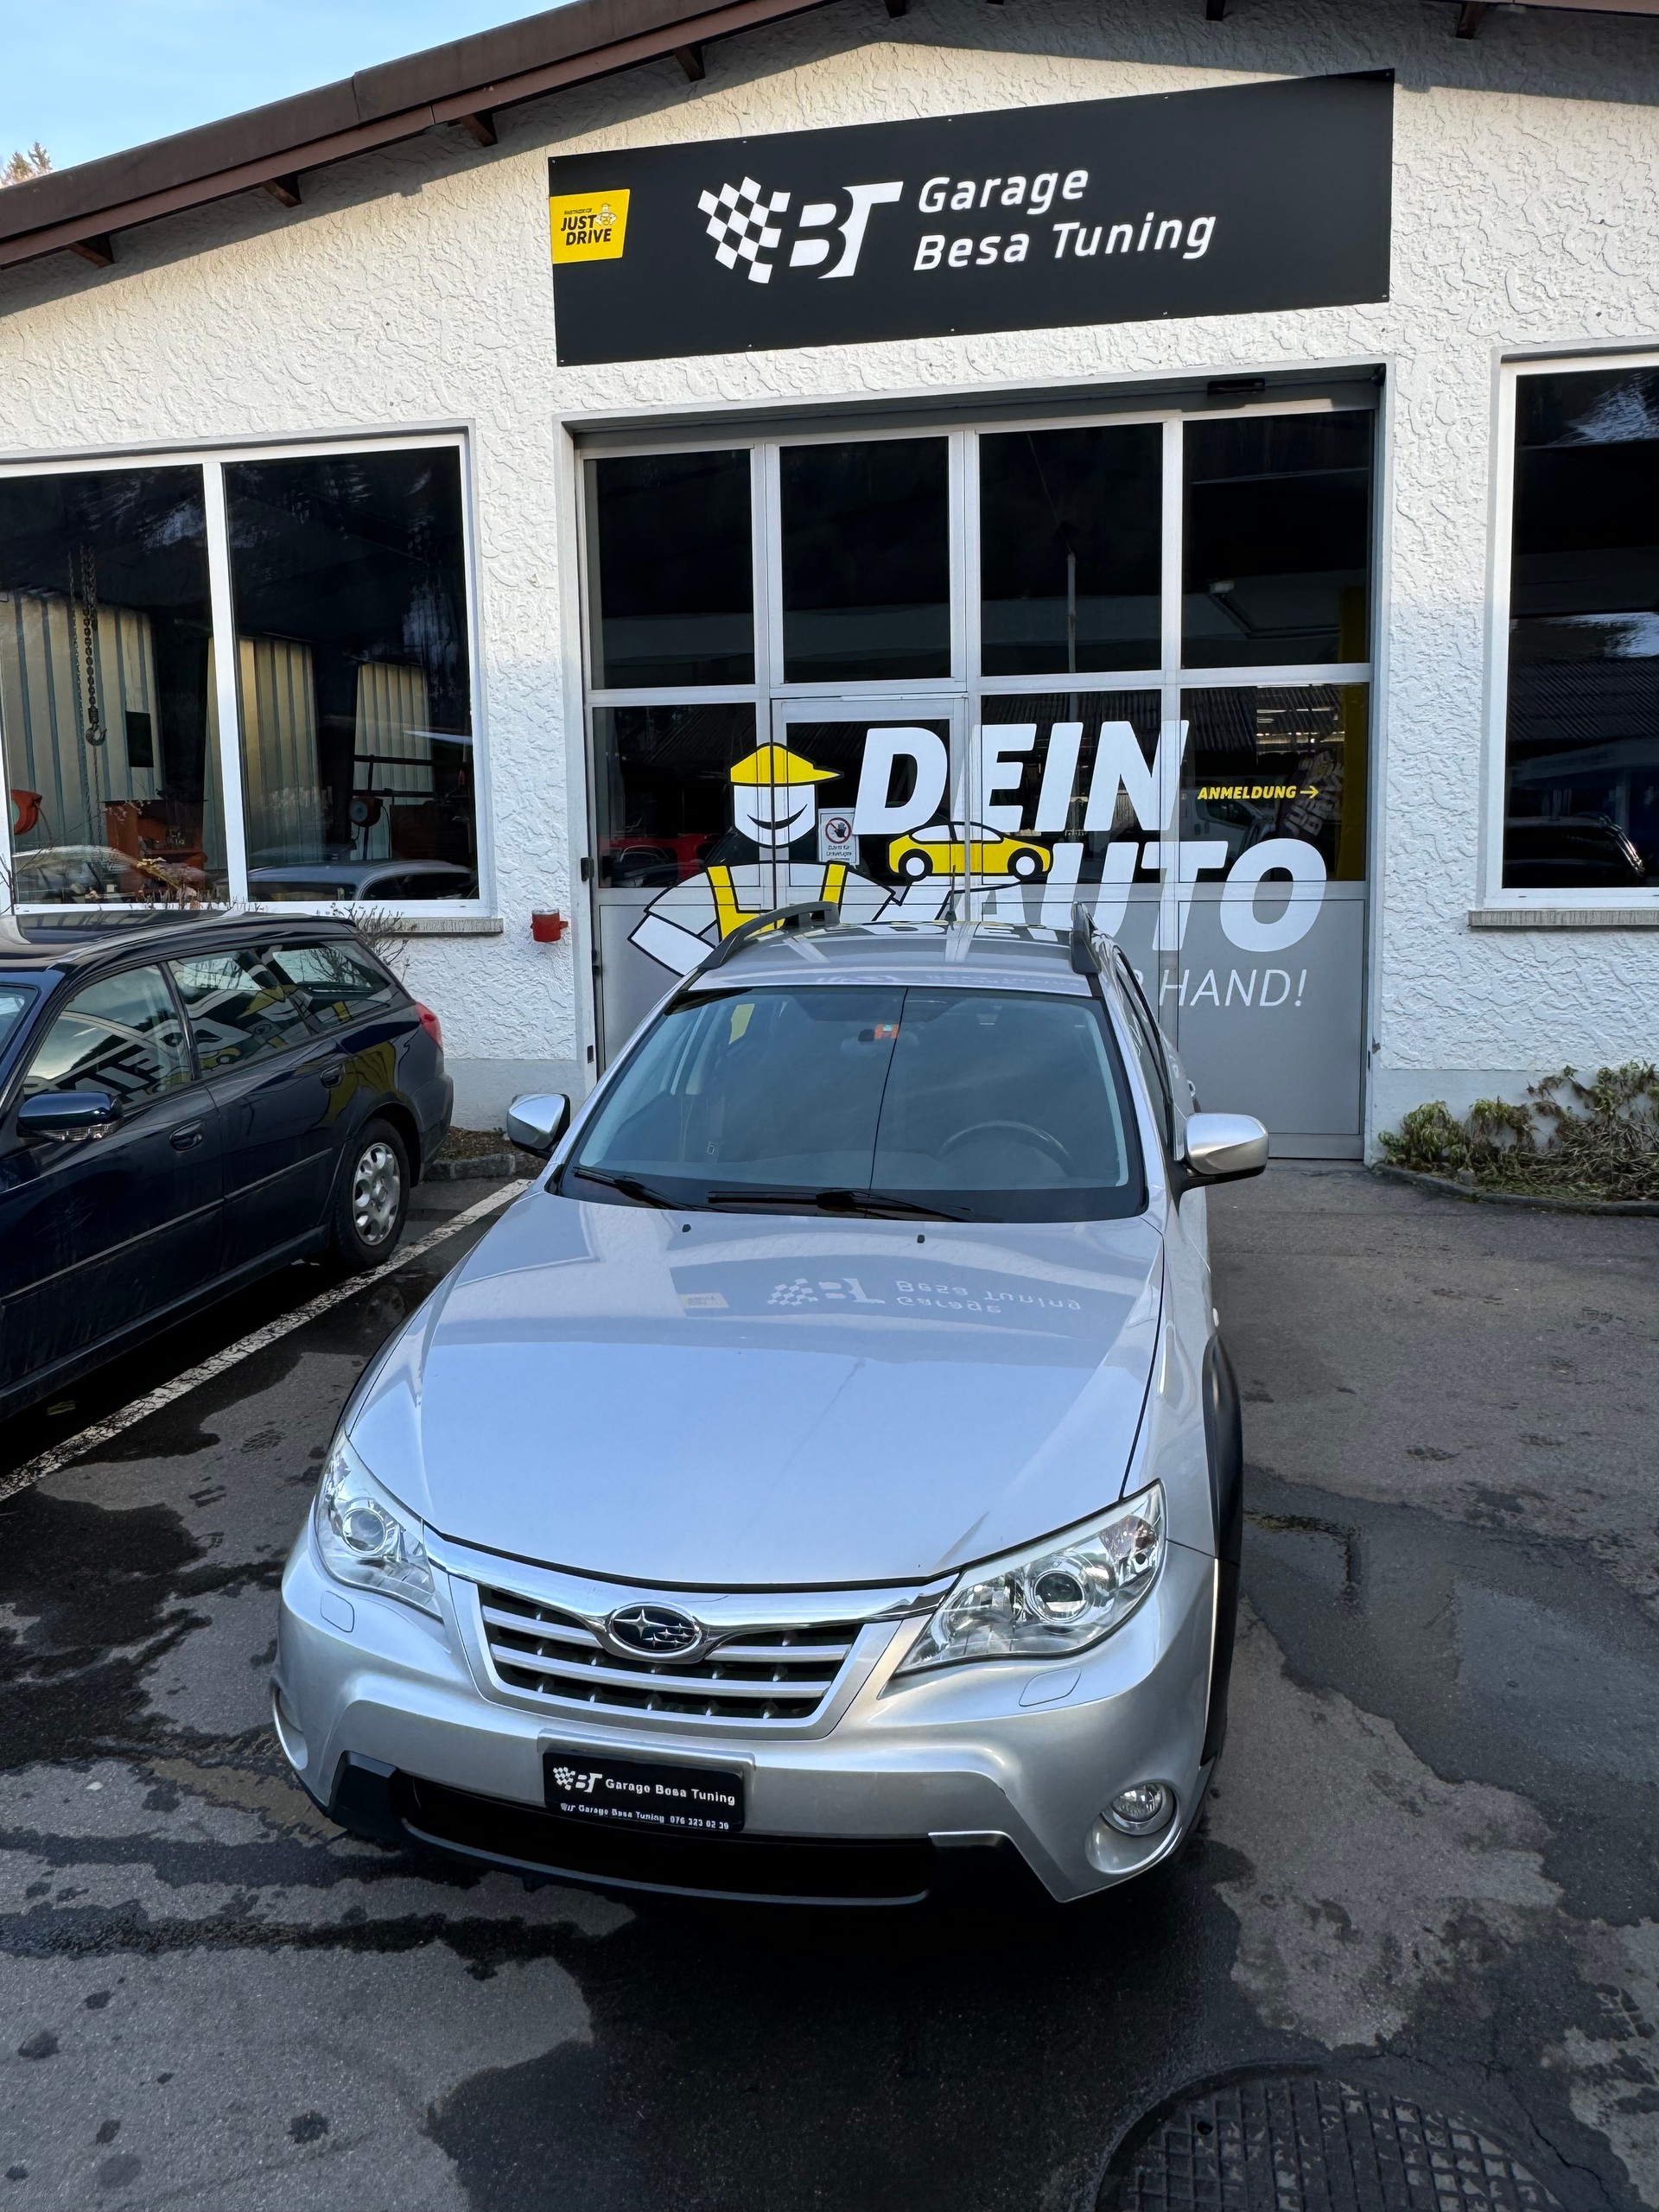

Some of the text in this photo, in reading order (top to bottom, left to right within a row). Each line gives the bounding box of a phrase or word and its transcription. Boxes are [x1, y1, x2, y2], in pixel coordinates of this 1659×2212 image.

[918, 169, 1089, 215] Garage
[560, 214, 598, 232] JUST
[565, 228, 612, 246] DRIVE
[789, 181, 904, 279] BT
[913, 212, 1217, 271] Besa Tuning
[853, 720, 1189, 836] DEIN
[1197, 785, 1297, 800] ANMELDUNG
[1159, 969, 1307, 1007] HAND!
[575, 1772, 603, 1793] BT
[605, 1778, 651, 1795] Garage
[691, 1789, 735, 1806] Tuning
[578, 1804, 609, 1816] Garage
[705, 1820, 716, 1828] 02
